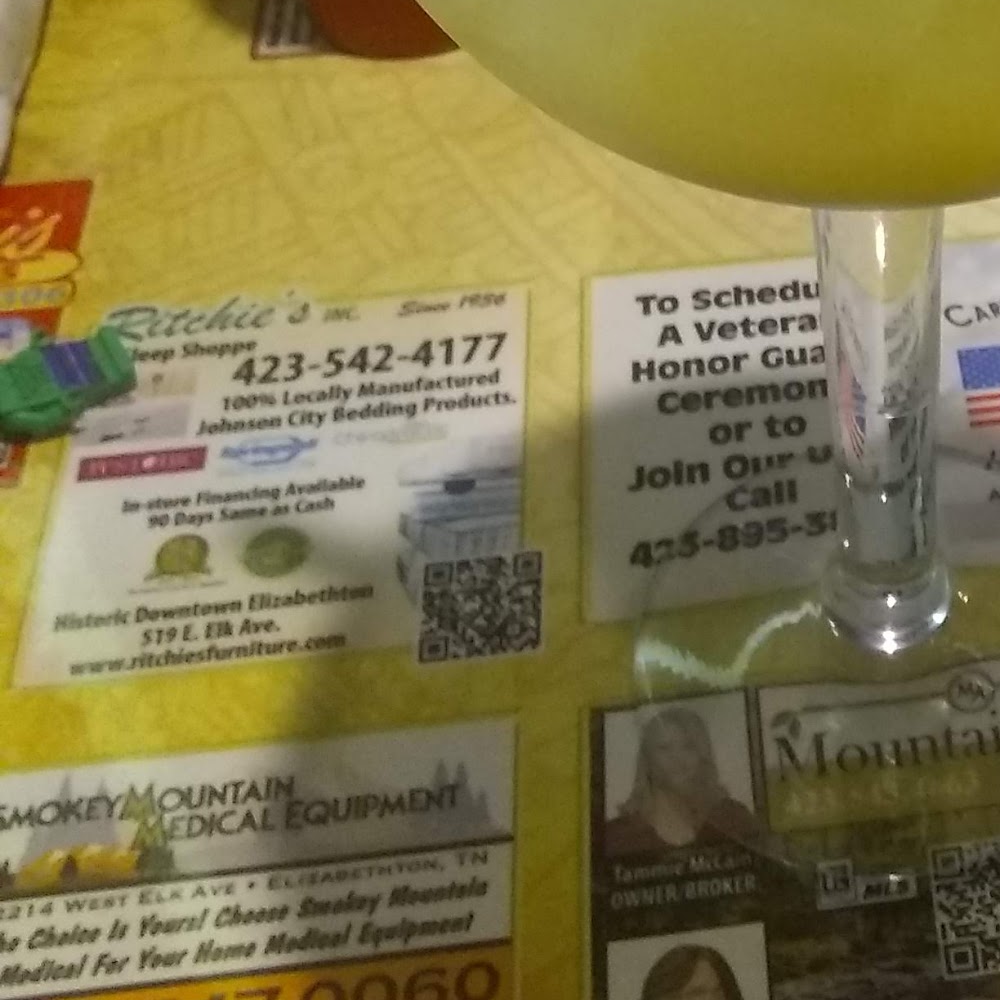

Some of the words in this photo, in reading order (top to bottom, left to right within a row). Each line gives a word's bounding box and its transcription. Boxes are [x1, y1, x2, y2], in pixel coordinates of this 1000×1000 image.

[635, 293, 680, 316] To
[181, 340, 258, 359] Shoppe
[657, 322, 684, 348] A
[231, 332, 508, 387] 423-542-4177
[631, 352, 750, 383] Honor
[222, 393, 277, 412] 100%
[283, 383, 353, 405] Locally
[357, 368, 501, 399] Manufactured
[657, 378, 829, 415] Ceremon
[196, 414, 282, 437] Johnson
[288, 409, 327, 429] City
[332, 401, 418, 422] Bedding
[708, 420, 752, 446] or
[763, 413, 808, 439] to
[197, 486, 281, 506] Financing
[285, 475, 366, 497] Available
[627, 459, 711, 493] Join
[147, 513, 170, 528] 90
[174, 510, 214, 527] Days
[219, 504, 268, 522] Same
[294, 497, 336, 514] Cash
[725, 477, 799, 512] Call
[53, 609, 131, 633] Historic
[135, 599, 243, 625] Downtown
[247, 584, 374, 612] Elizabethton
[142, 627, 179, 647] 519
[204, 619, 234, 640] Elk
[70, 632, 347, 676] www.ritchiesfurniture.com
[121, 775, 295, 821] MOUNTAIN
[285, 783, 460, 831] EQUIPMENT
[65, 895, 129, 913] WEST
[191, 881, 235, 899] AVE
[456, 850, 489, 865] TN
[214, 903, 289, 929] Choose
[388, 875, 488, 907] Mountain
[92, 951, 130, 977] For
[138, 945, 189, 970] Your
[193, 938, 257, 964] Home
[264, 921, 352, 955] Medical
[357, 910, 475, 950] Equipment
